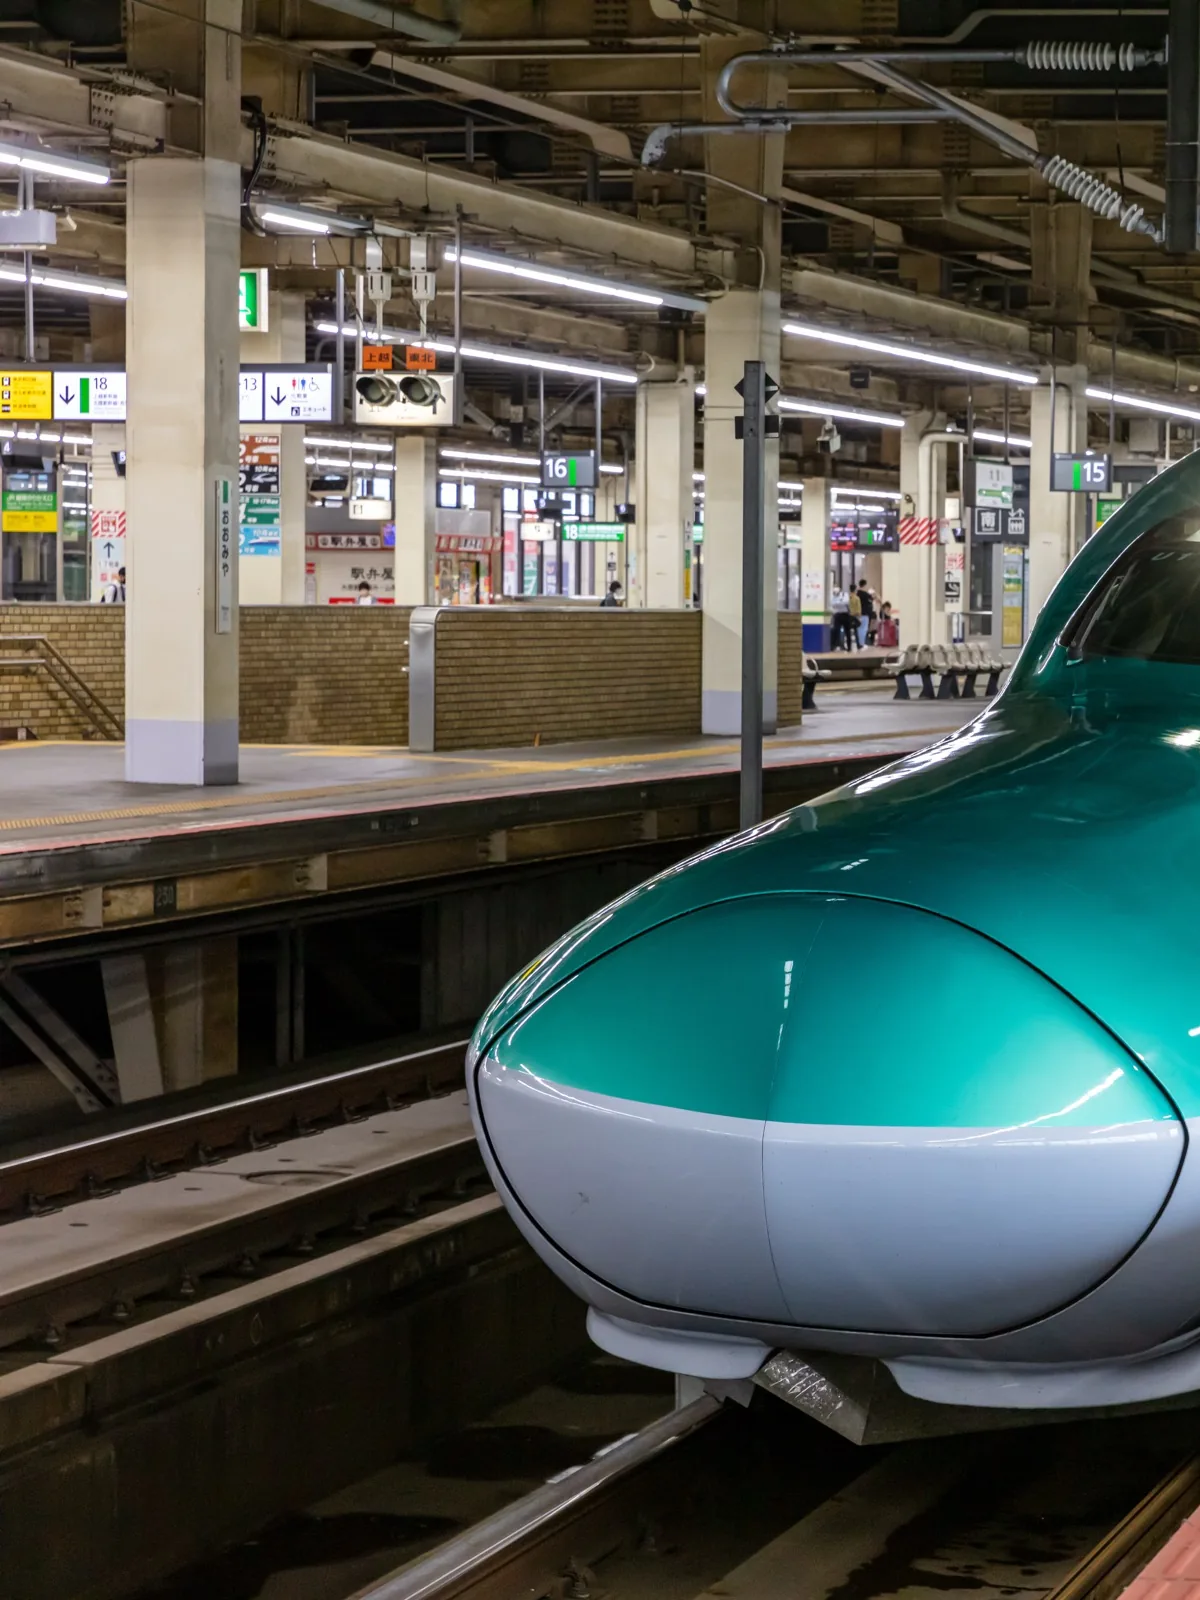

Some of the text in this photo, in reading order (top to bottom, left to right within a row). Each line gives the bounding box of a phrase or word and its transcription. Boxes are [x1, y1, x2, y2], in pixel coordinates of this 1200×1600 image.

[365, 352, 391, 363] 上越
[93, 376, 108, 391] 18
[545, 458, 567, 478] 16
[1082, 461, 1106, 483] 15
[981, 511, 996, 532] 南
[564, 523, 579, 540] 18
[872, 530, 885, 542] 17
[221, 510, 230, 577] おおみや
[331, 536, 368, 547] 駅弁屋
[351, 567, 395, 581] 駅弁屋
